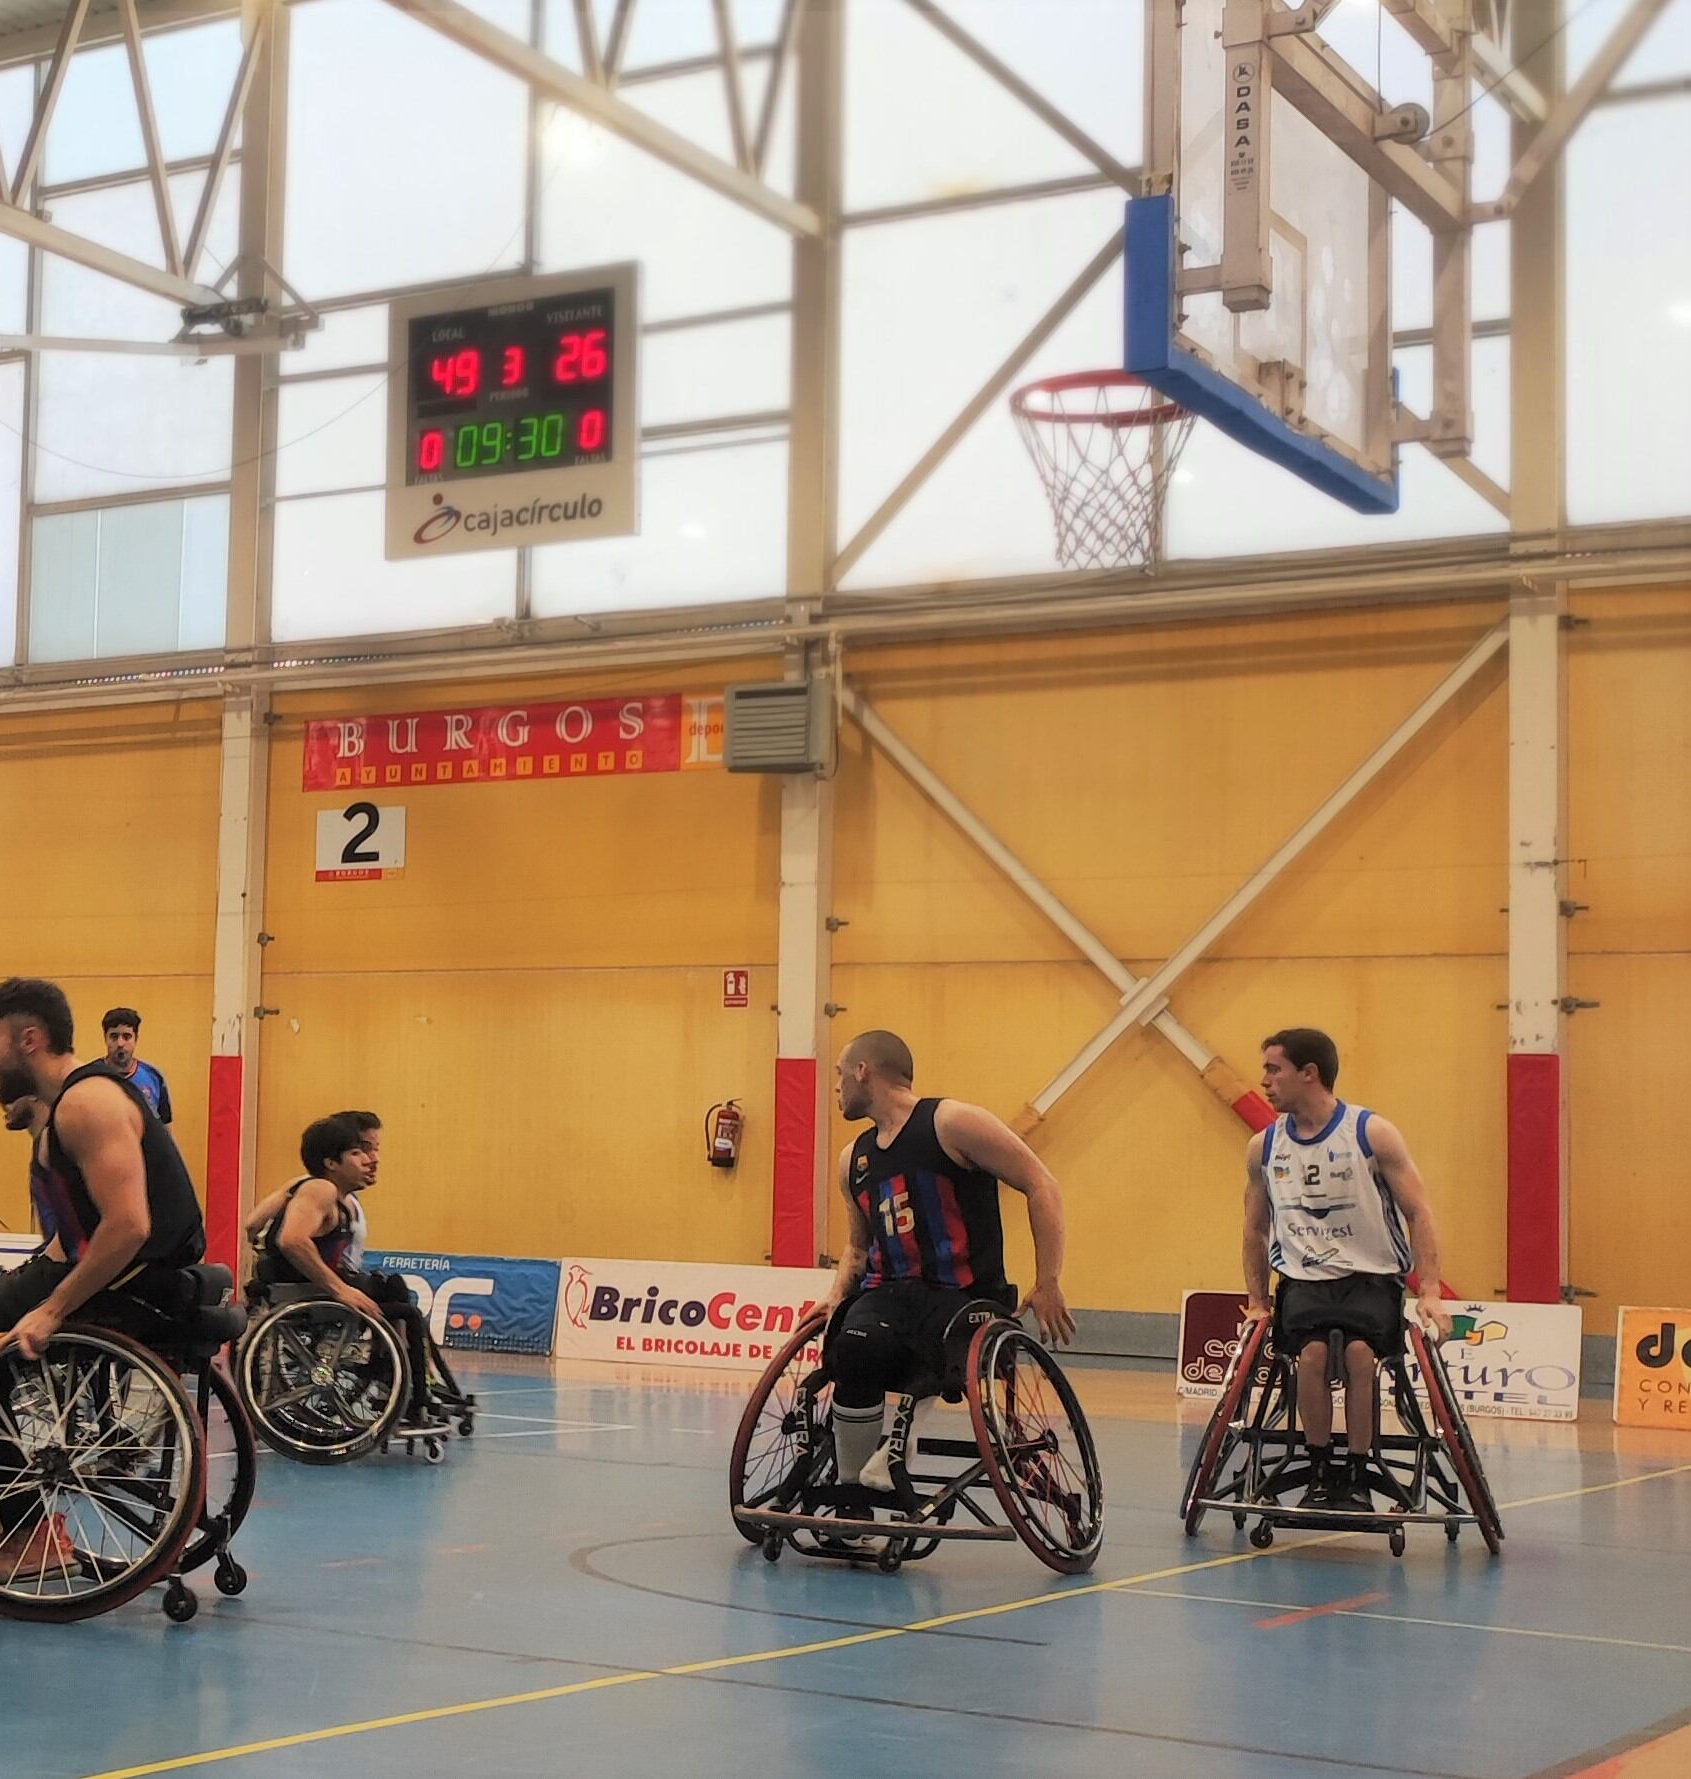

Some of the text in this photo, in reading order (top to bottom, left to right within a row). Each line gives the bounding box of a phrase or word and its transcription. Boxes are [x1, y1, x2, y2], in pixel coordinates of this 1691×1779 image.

[1234, 85, 1252, 148] DASA
[432, 327, 465, 343] LOCAL
[546, 304, 604, 324] VISITANTE
[431, 328, 607, 396] 49 3 26
[419, 410, 605, 470] 0 09:30 0
[464, 492, 604, 537] cajacírculo
[337, 700, 645, 759] BURGOS
[337, 751, 643, 785] AYUNTAMIENTO
[341, 801, 381, 864] 2
[878, 1191, 916, 1237] 15
[382, 1255, 451, 1272] FERRETERÍA
[615, 1335, 821, 1365] EL BRICOLAJE DE UR
[1635, 1322, 1691, 1369] d
[1637, 1397, 1688, 1414] Y RE
[1638, 1378, 1691, 1395] CON
